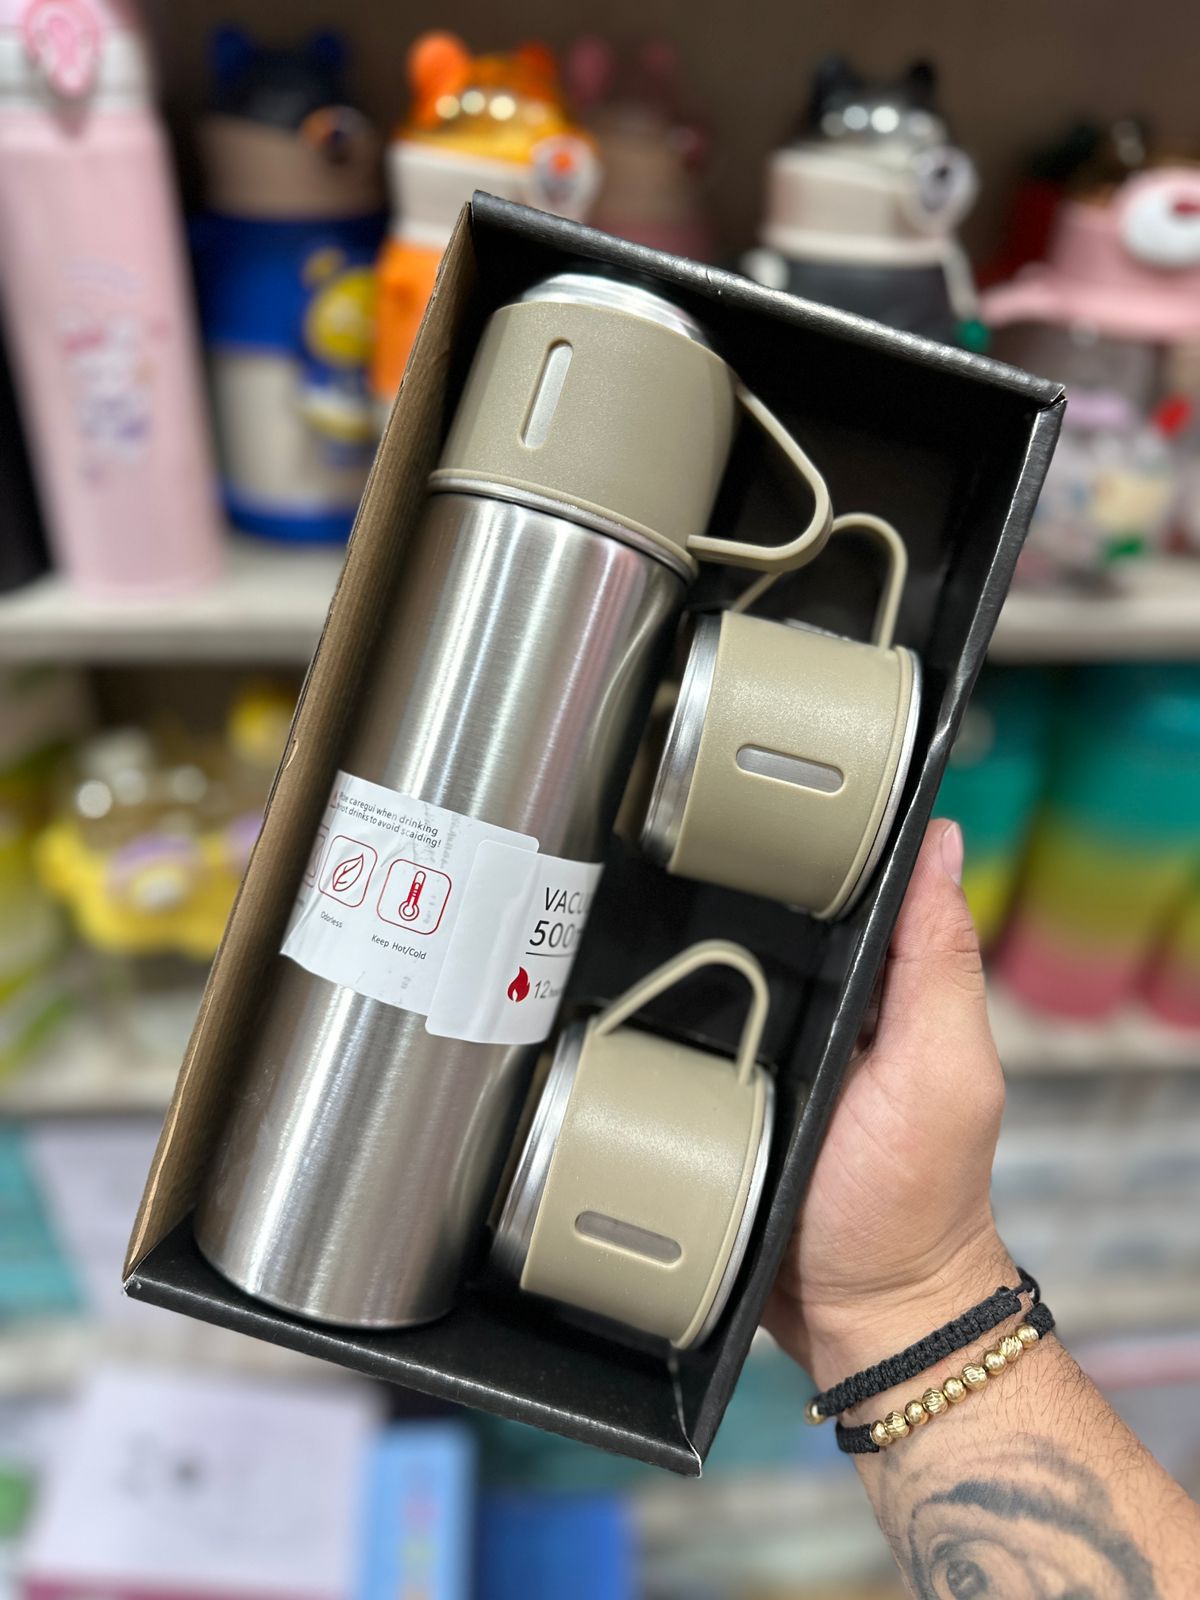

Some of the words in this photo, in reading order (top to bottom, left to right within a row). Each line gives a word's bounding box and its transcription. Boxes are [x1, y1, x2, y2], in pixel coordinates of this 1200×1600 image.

[349, 808, 369, 821] drinks
[370, 816, 377, 824] to
[378, 821, 400, 832] avoid
[376, 808, 398, 820] when
[399, 815, 438, 837] drinking
[371, 934, 390, 948] Keep
[392, 942, 427, 960] Hot/Cold
